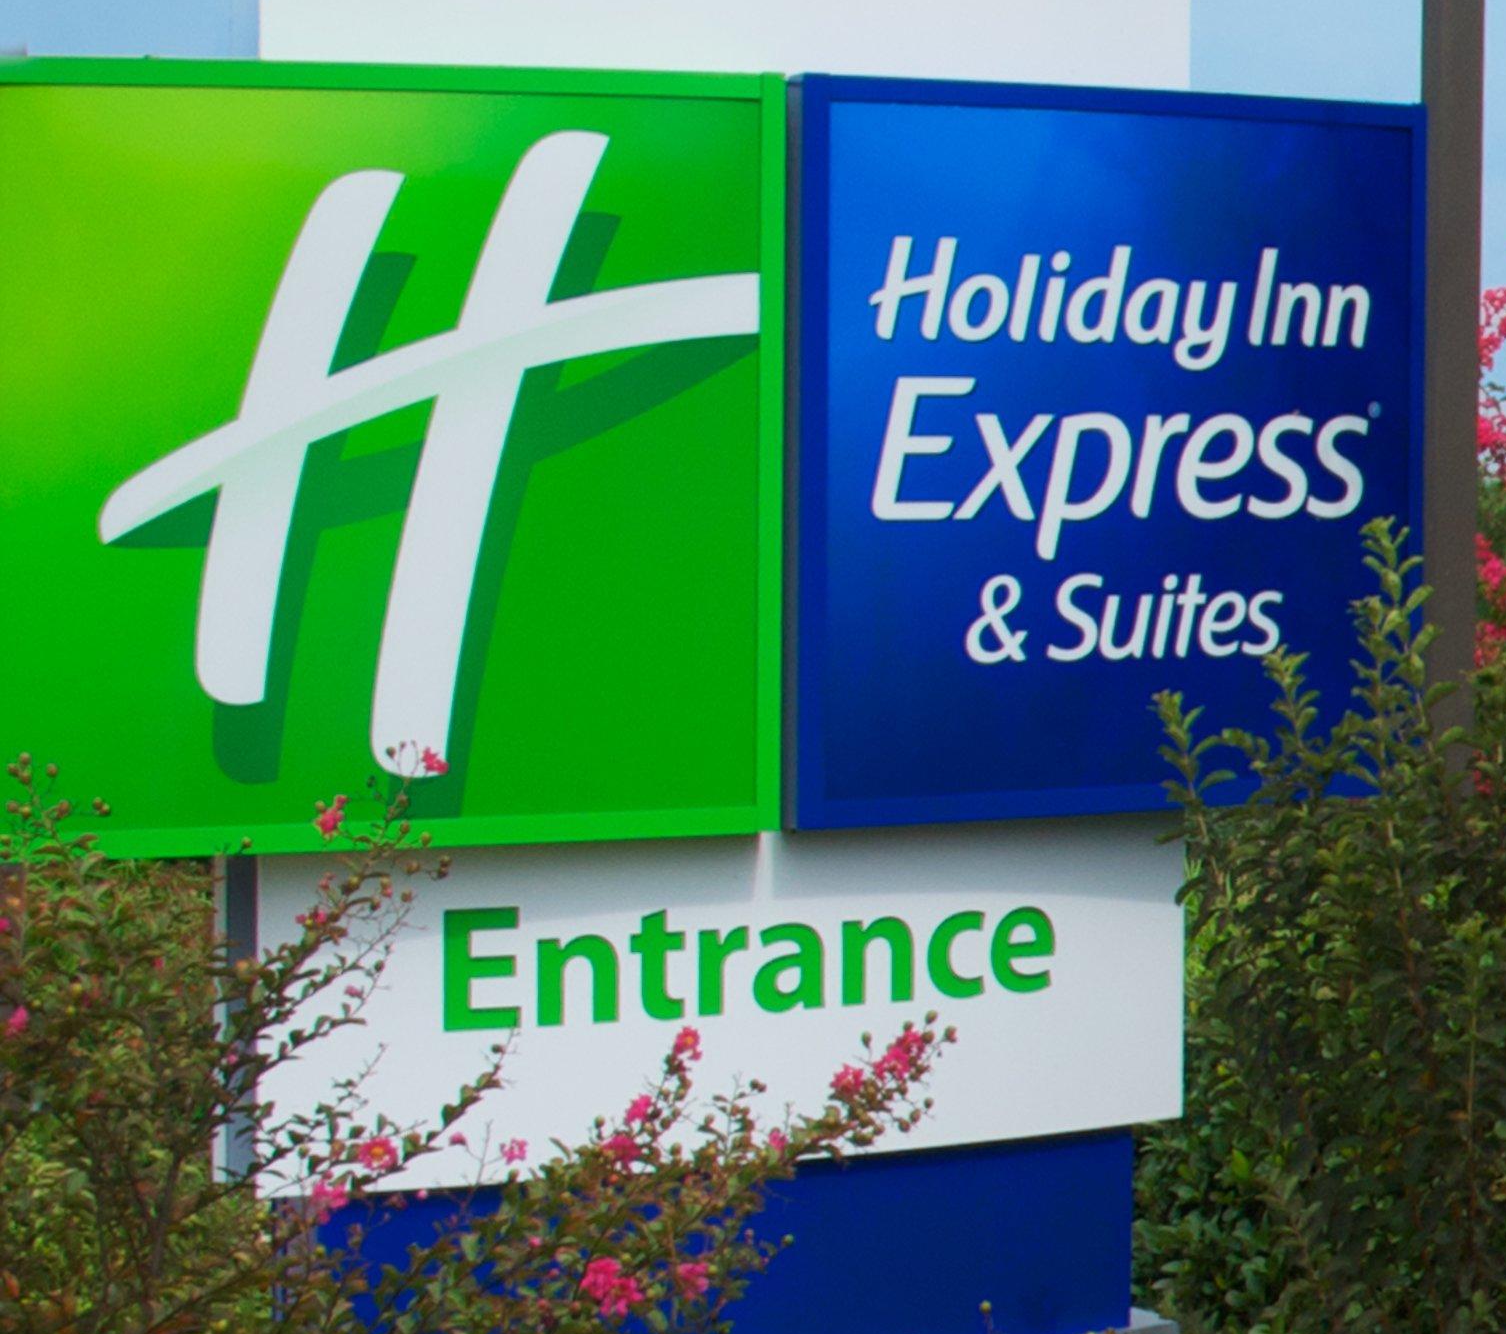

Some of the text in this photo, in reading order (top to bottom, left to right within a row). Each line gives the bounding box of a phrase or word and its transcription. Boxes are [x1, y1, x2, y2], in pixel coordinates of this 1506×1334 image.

[868, 235, 1371, 371] Holiday Inn
[870, 376, 1370, 561] Express
[964, 572, 1284, 664] & Suites
[441, 903, 1057, 1034] Entrance
